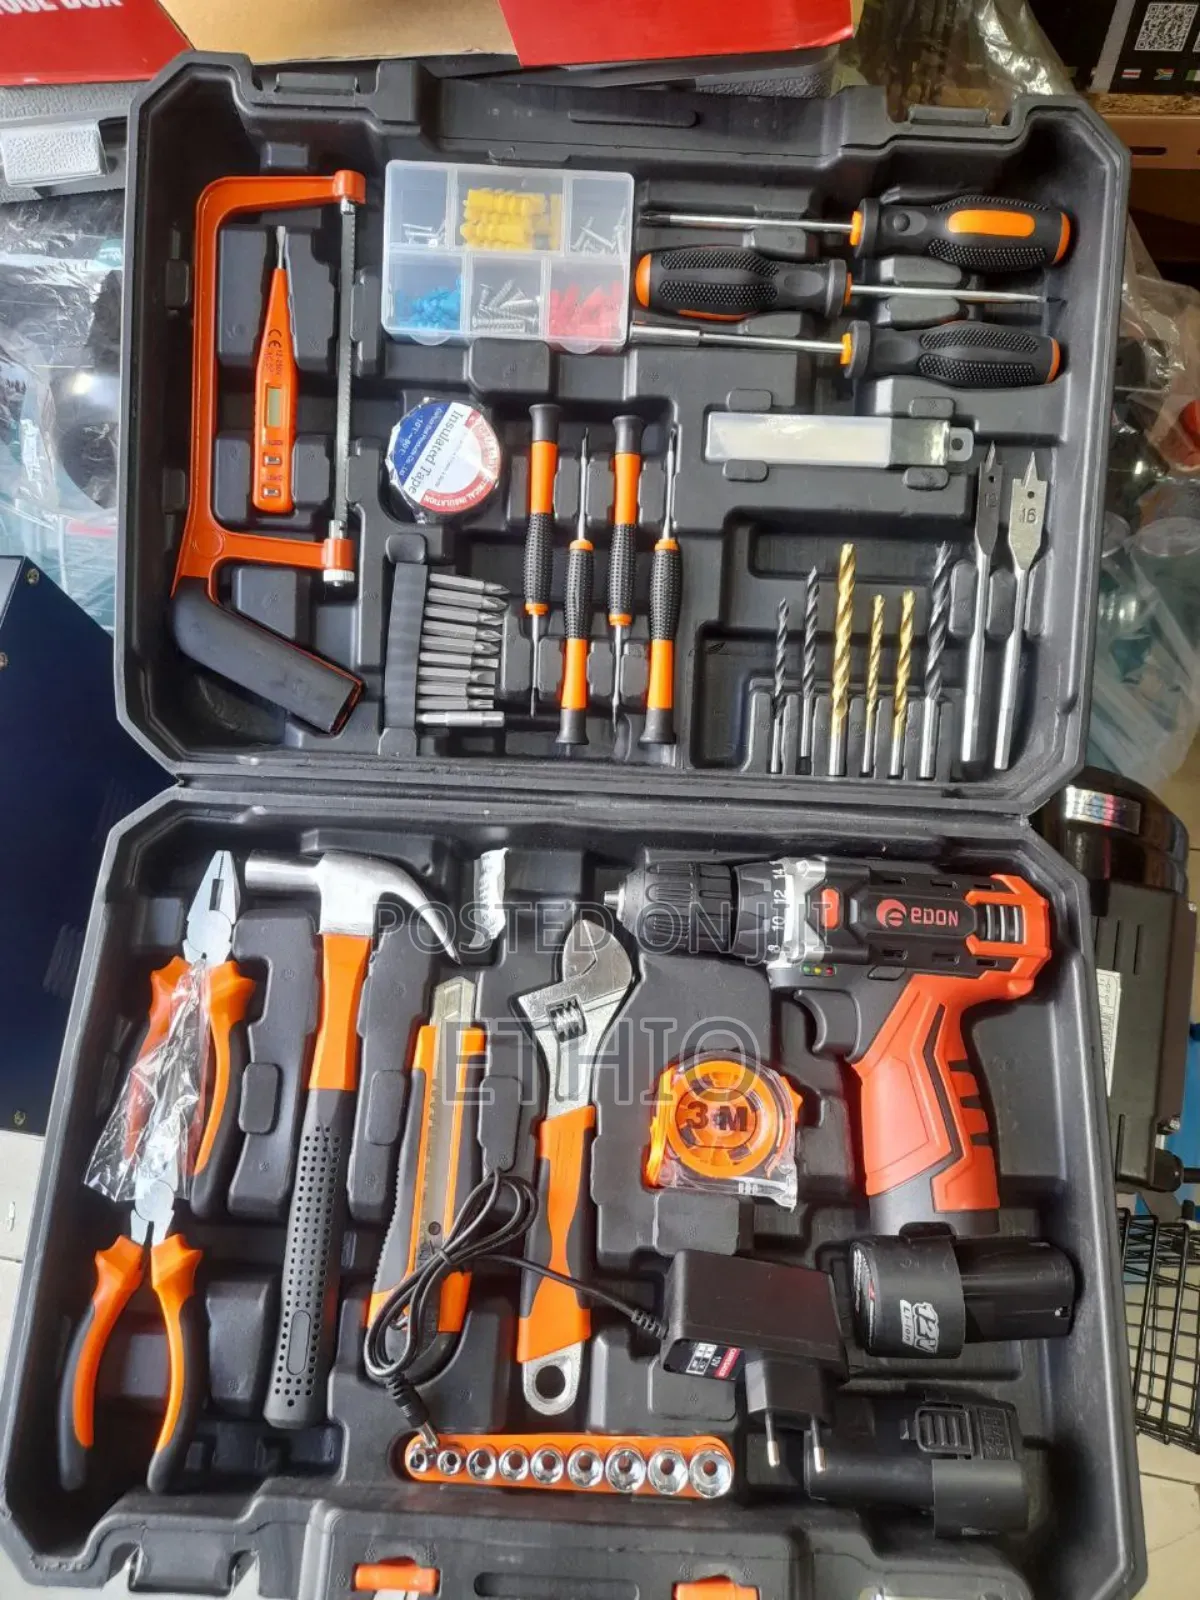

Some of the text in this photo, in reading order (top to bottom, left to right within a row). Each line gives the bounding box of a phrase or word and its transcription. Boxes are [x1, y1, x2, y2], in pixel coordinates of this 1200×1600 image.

[423, 409, 465, 467] Insulated
[407, 464, 432, 495] Tape
[1021, 508, 1038, 524] 16
[772, 868, 786, 880] 14
[773, 889, 786, 905] 12
[771, 915, 786, 931] 10
[913, 1302, 940, 1354] 12V
